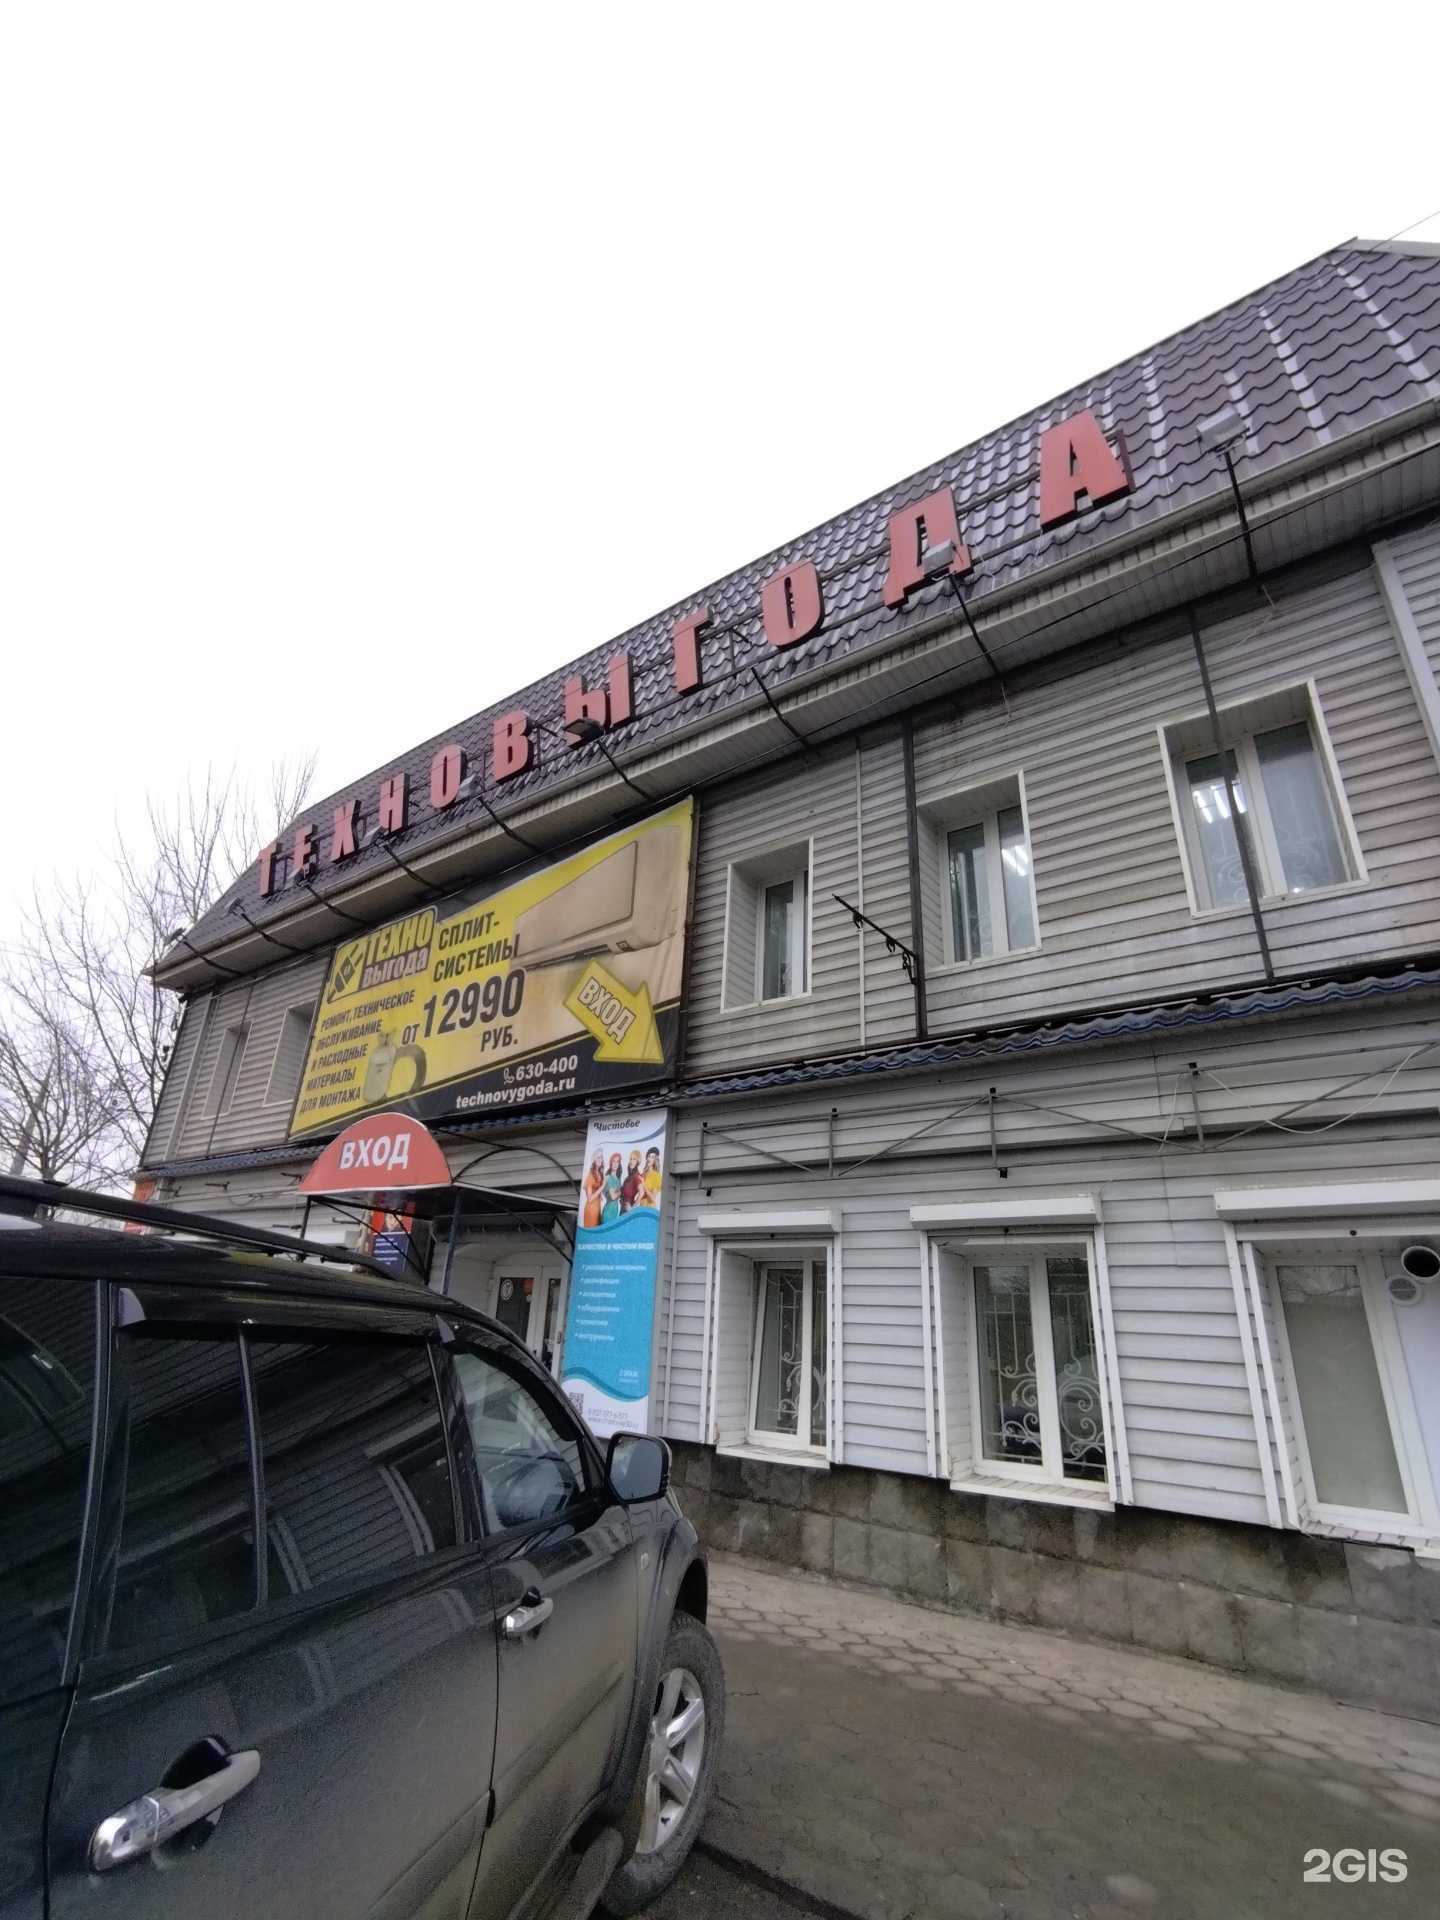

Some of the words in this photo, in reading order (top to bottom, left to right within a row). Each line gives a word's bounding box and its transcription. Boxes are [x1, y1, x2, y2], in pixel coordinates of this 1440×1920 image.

[438, 911, 500, 950] СПЛИТ-
[433, 933, 520, 983] СИСТЕМЫ
[353, 990, 415, 1018] ТЕХНИЧЕСКОЕ
[401, 1023, 420, 1045] ОТ
[424, 968, 525, 1038] 12990
[577, 976, 637, 1045] ВХОД
[481, 1025, 518, 1052] РУБ.
[318, 1043, 368, 1069] РАСХОДНЫЕ
[515, 1054, 578, 1082] 630-400
[318, 1087, 361, 1108] МОНТАЖА
[456, 1076, 576, 1109] technovygoda.ru
[340, 1133, 411, 1170] ВХОД
